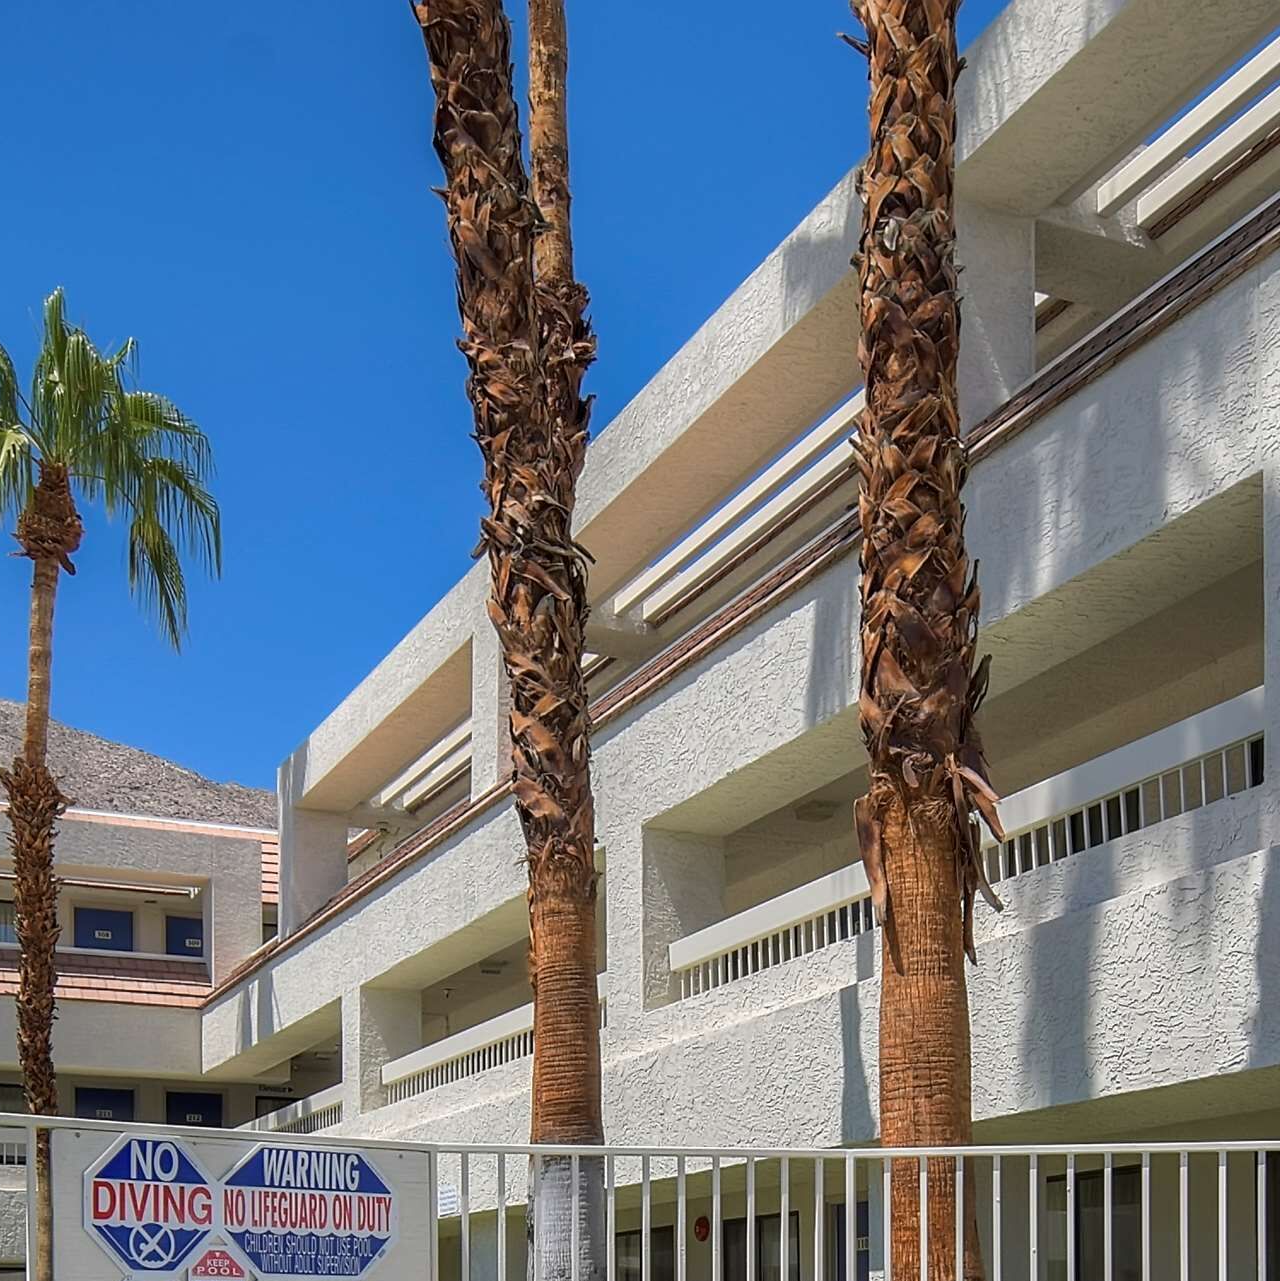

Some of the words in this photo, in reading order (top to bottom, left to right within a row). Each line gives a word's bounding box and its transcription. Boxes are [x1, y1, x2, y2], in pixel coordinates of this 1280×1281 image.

[130, 1141, 178, 1181] NO
[264, 1149, 360, 1191] WARNING
[93, 1181, 211, 1225] DIVING
[224, 1189, 246, 1227] NO
[251, 1190, 328, 1230] LIFEGUARD
[332, 1194, 352, 1231] ON
[358, 1196, 392, 1232] DUTY
[245, 1233, 283, 1253] CHILDREN
[286, 1235, 316, 1255] SHOULD
[319, 1236, 335, 1255] NOT
[336, 1237, 351, 1256] USE
[353, 1238, 373, 1257] POOL
[260, 1254, 293, 1273] WITHOUT
[294, 1255, 316, 1274] ADULT
[317, 1256, 361, 1275] SUPERVISION
[197, 1266, 240, 1276] POOL
